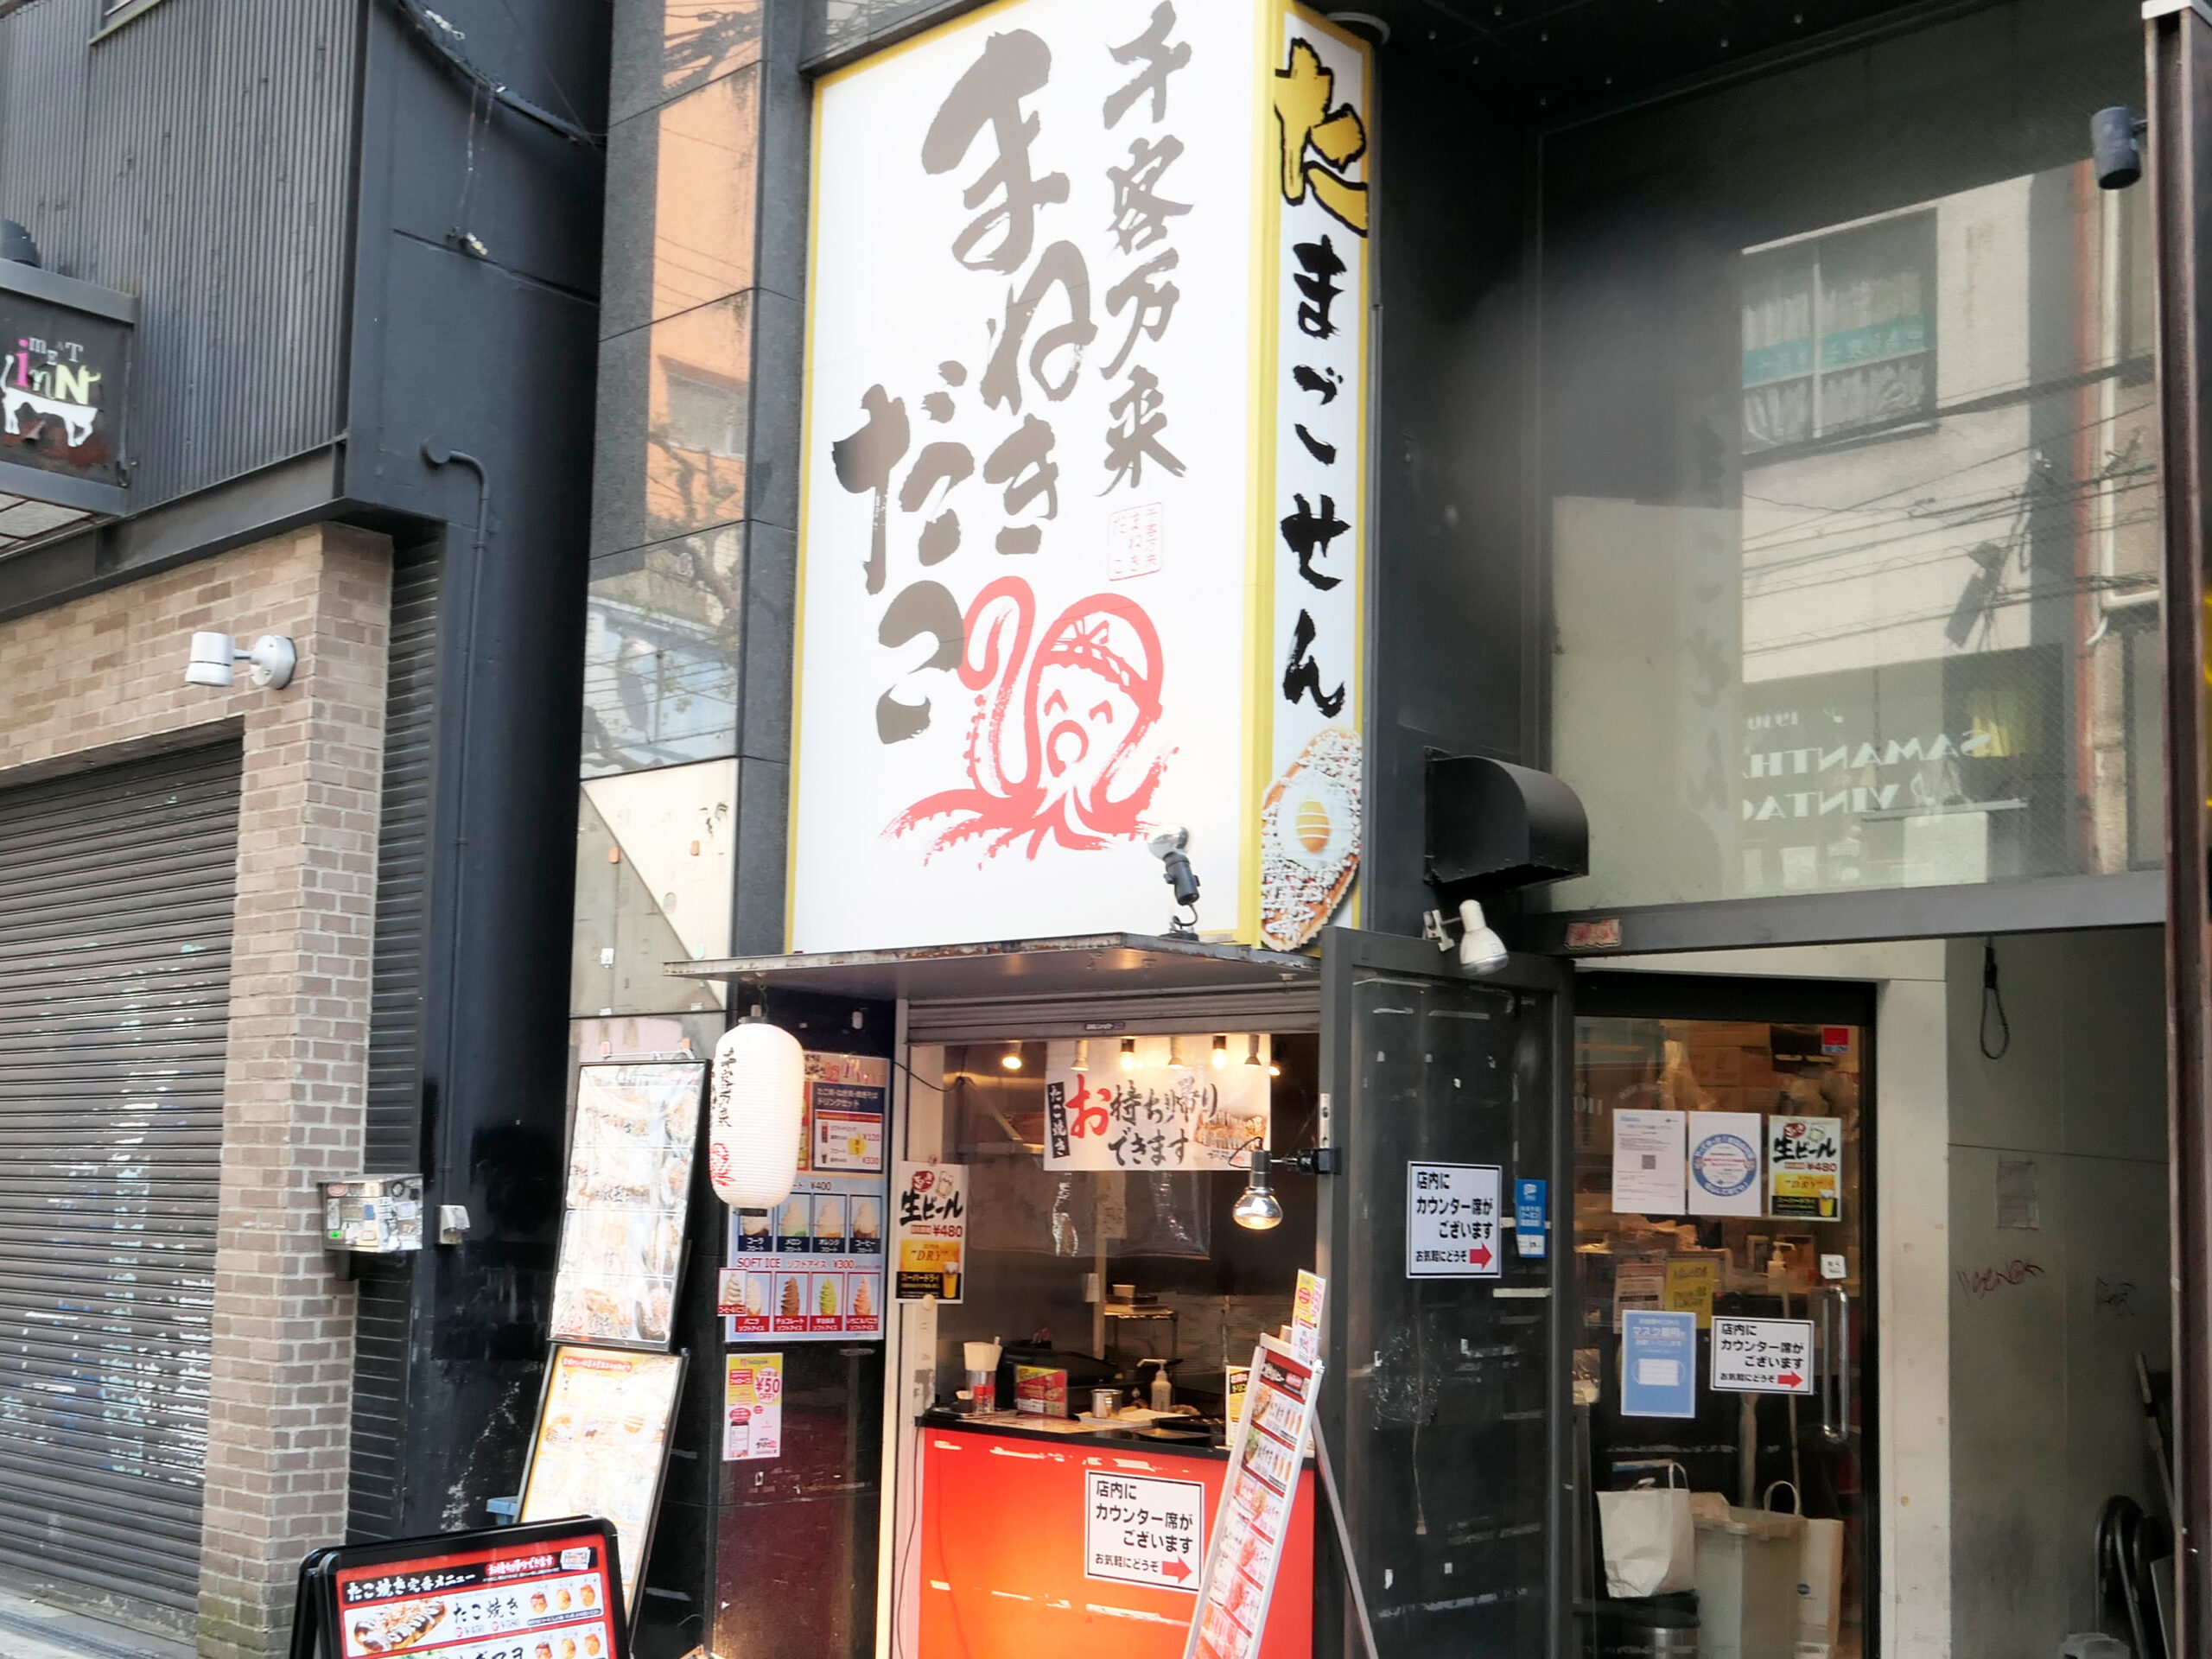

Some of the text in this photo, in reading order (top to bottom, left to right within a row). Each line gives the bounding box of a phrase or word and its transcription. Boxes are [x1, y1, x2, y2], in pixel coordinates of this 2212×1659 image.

[921, 29, 1098, 556] まねき
[1065, 1073, 1218, 1139] お持ち帰り
[1049, 1084, 1067, 1158] たこ焼き
[1109, 1127, 1189, 1167] できます
[1773, 1137, 1837, 1163] 生ビール
[810, 1182, 832, 1191] ¥400
[1416, 1171, 1450, 1190] 店内に
[899, 1187, 963, 1226] 生ビール
[1416, 1196, 1493, 1216] カウンター席が
[933, 1224, 963, 1237] ¥480
[1439, 1220, 1493, 1239] ございます
[737, 1258, 762, 1268] SOFT
[766, 1258, 781, 1268] ICE
[787, 1260, 827, 1268] ソフトアイス
[834, 1260, 855, 1269] ¥300
[1415, 1249, 1468, 1262] お気軽にどうぞ
[1721, 1323, 1757, 1336] 店内に
[1720, 1338, 1805, 1354] カウンター席が
[1744, 1356, 1804, 1370] ございます
[755, 1377, 780, 1393] ¥50
[1096, 1480, 1137, 1500] 店内に
[1096, 1503, 1193, 1531] カウンター席が
[1123, 1529, 1193, 1554] ございます
[1095, 1554, 1160, 1573] お気軽にどうぞ
[453, 1596, 518, 1624] たこ焼き
